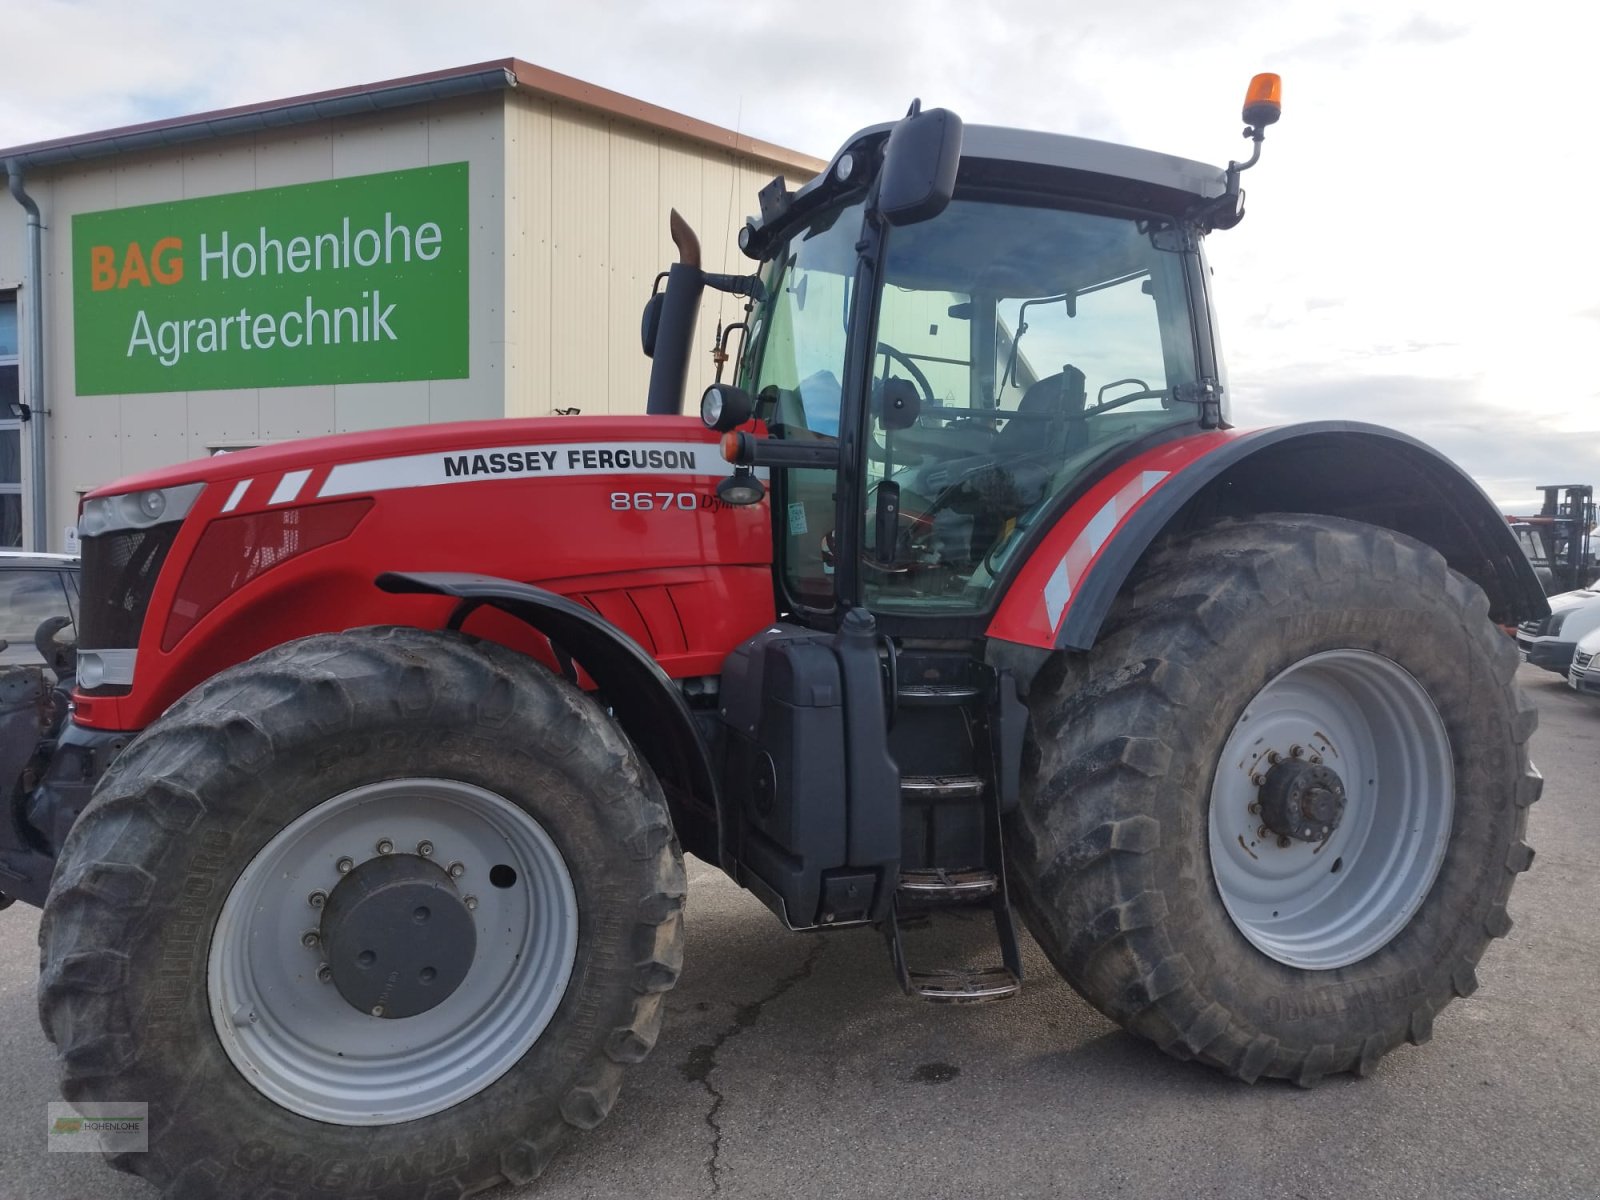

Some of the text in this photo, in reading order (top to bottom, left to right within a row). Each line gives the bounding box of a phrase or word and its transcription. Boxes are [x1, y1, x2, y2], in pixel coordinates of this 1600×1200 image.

[92, 212, 442, 291] BAG Hohenlohe
[126, 291, 398, 366] Agrartechnik
[444, 450, 695, 476] MASSEY FERGUSON
[610, 493, 697, 512] 8670
